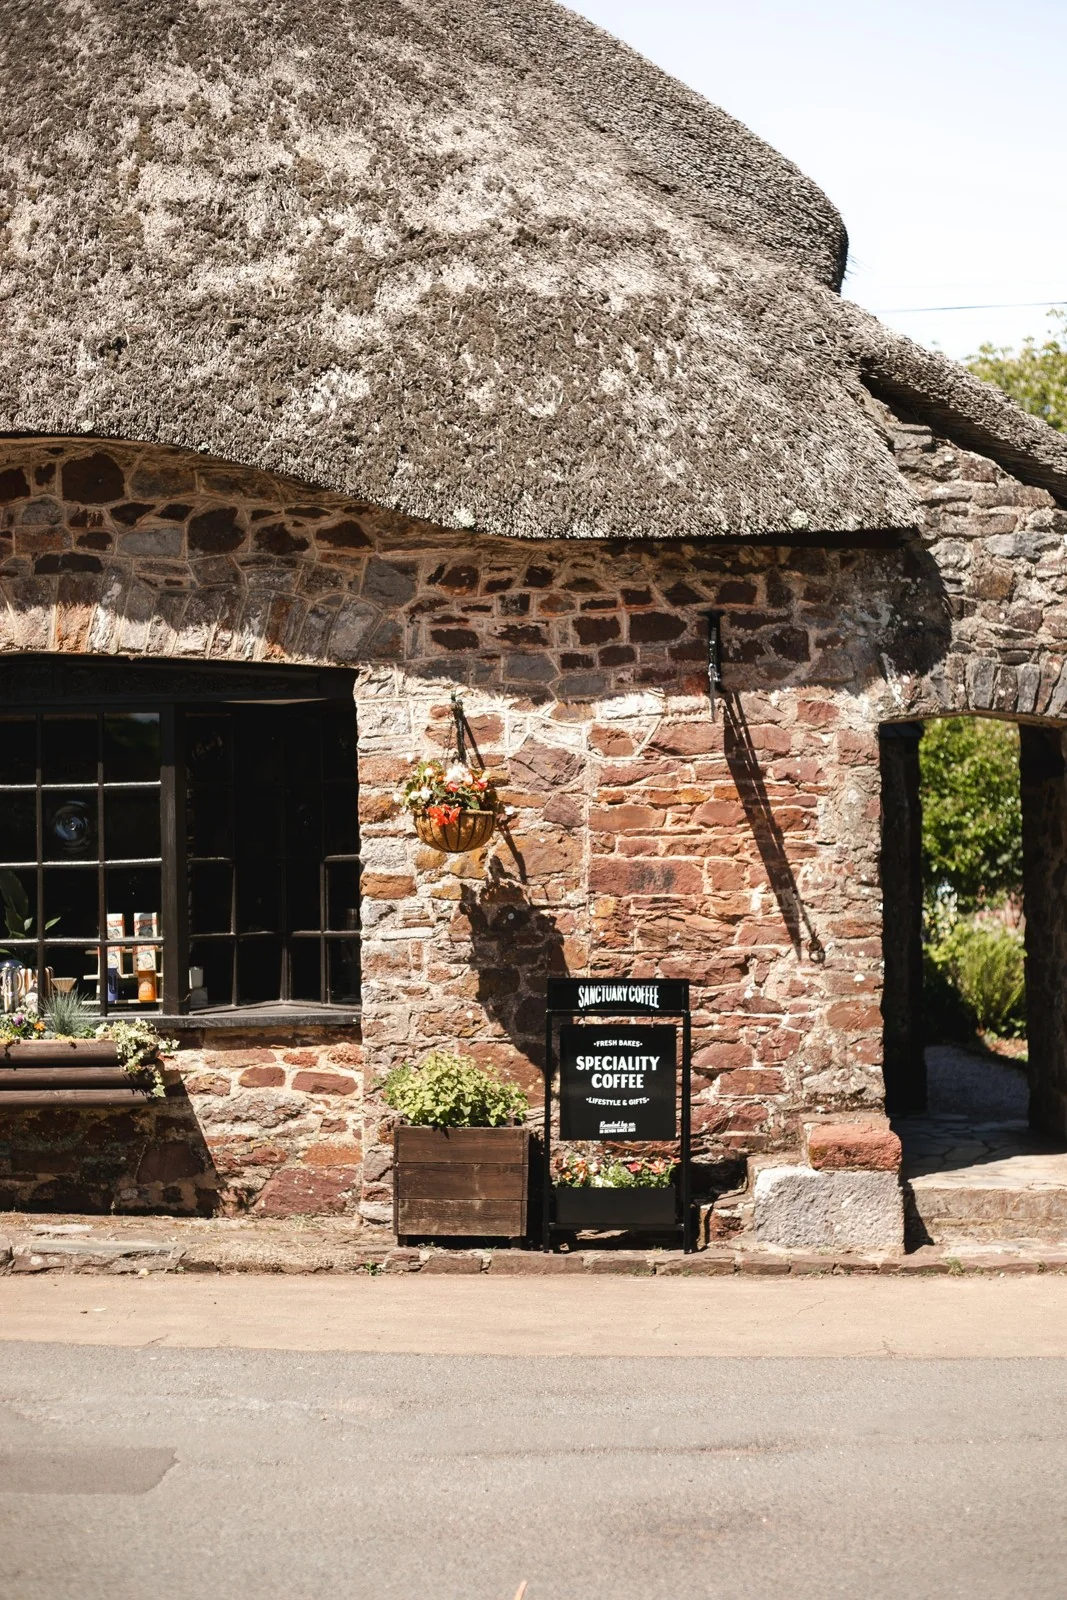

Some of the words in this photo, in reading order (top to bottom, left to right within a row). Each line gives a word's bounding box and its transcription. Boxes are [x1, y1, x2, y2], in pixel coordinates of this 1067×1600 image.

[578, 985, 628, 1008] SANCTUARY
[628, 985, 660, 1009] COFFEE
[576, 1056, 660, 1071] SPECIALITY
[591, 1073, 644, 1088] COFFEE
[588, 1097, 621, 1106] LIFESTYLE
[628, 1097, 647, 1105] GIFTS
